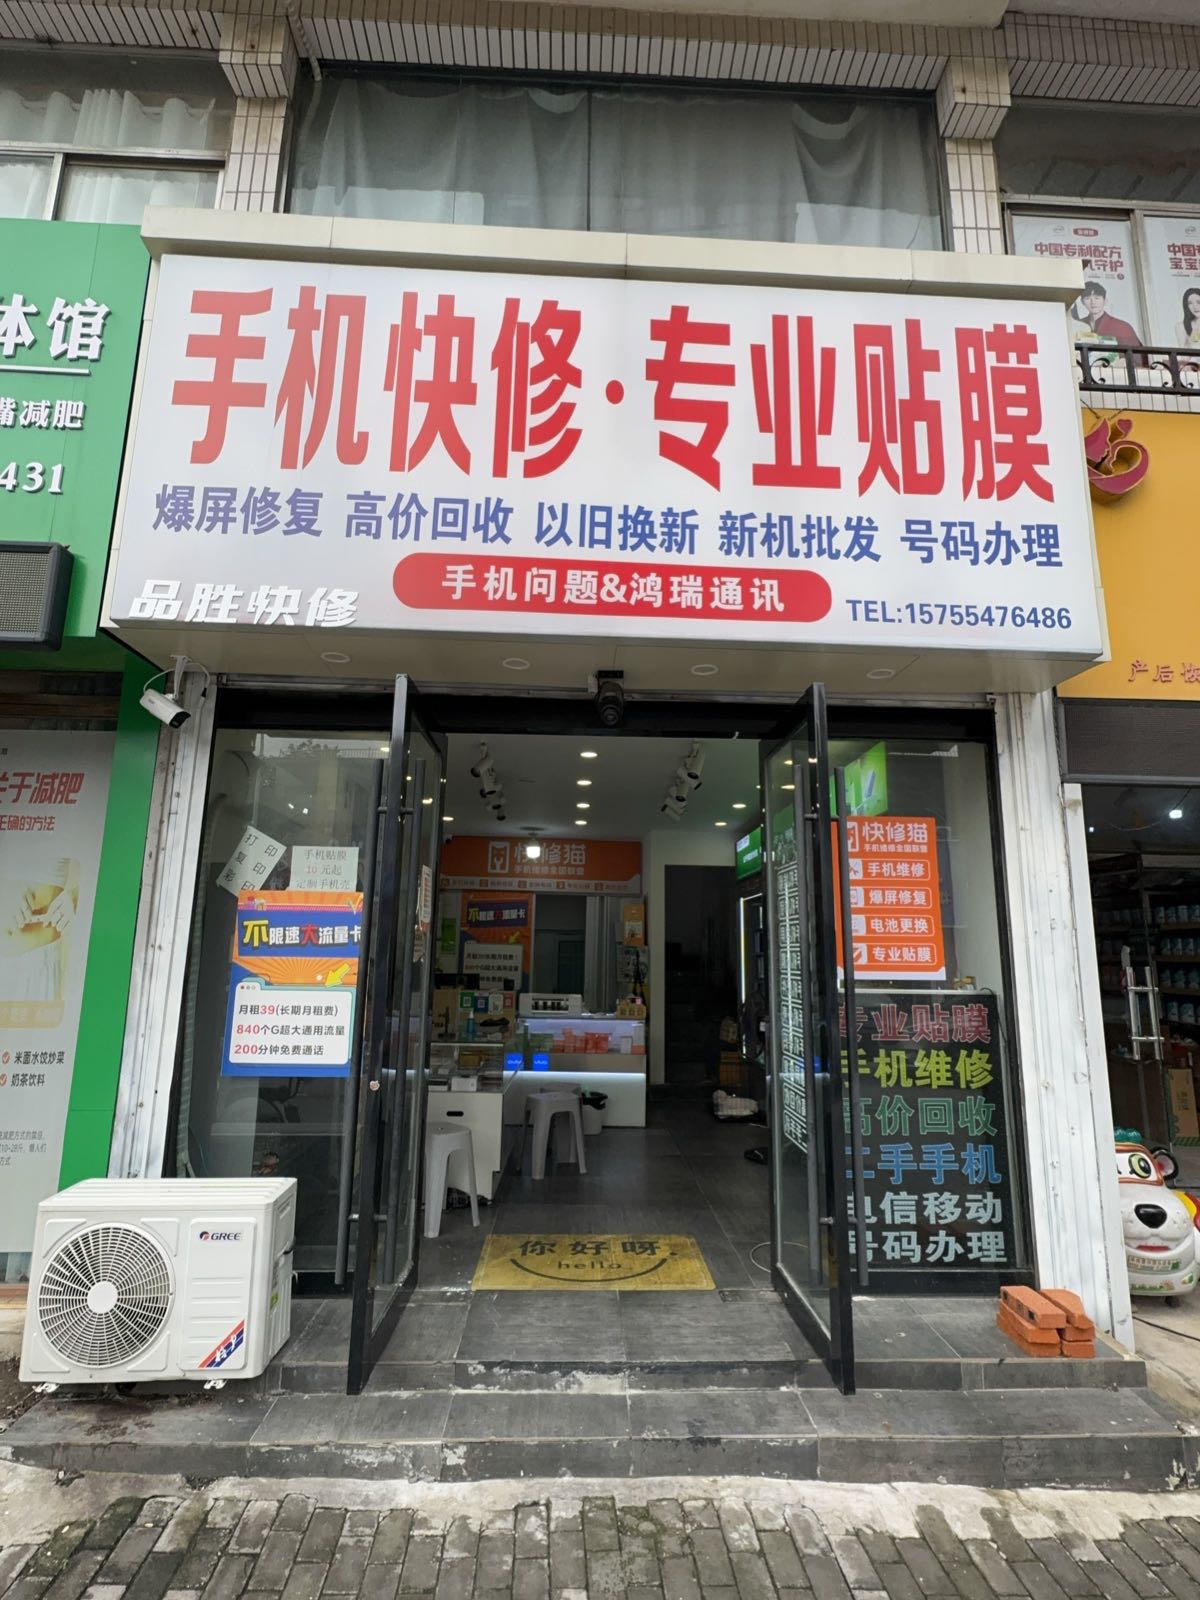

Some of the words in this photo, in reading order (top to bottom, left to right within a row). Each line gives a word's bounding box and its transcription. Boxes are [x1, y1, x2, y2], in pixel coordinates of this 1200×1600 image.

[1034, 242, 1122, 259] 中国专利配方
[0, 462, 64, 494] 431
[153, 483, 323, 537] 爆屏修复
[345, 490, 514, 544] 高价回收
[534, 501, 699, 556] 以旧换新
[718, 510, 881, 563] 新机批发
[900, 519, 1063, 568] 号码办理
[442, 564, 785, 612] 手机问题&鸿瑞通讯
[128, 579, 359, 628] 品胜快修
[846, 599, 1073, 630] TEL:15755476486
[862, 821, 928, 843] 快修猫
[244, 834, 279, 857] 打印
[235, 851, 267, 875] 复印
[868, 862, 925, 877] 手机维修
[869, 889, 927, 906] 爆屏修复
[243, 920, 361, 947] 不限速大流量卡
[871, 918, 929, 934] 电池更换
[873, 946, 932, 962] 专业贴膜
[14, 1051, 66, 1065] 米面水饺炒菜
[234, 1044, 325, 1056] 200分钟免费通话
[10, 1073, 45, 1087] 奶茶饮料
[210, 1231, 241, 1241] GREE
[518, 1239, 661, 1257] 你好呀
[558, 1260, 622, 1270] hello
